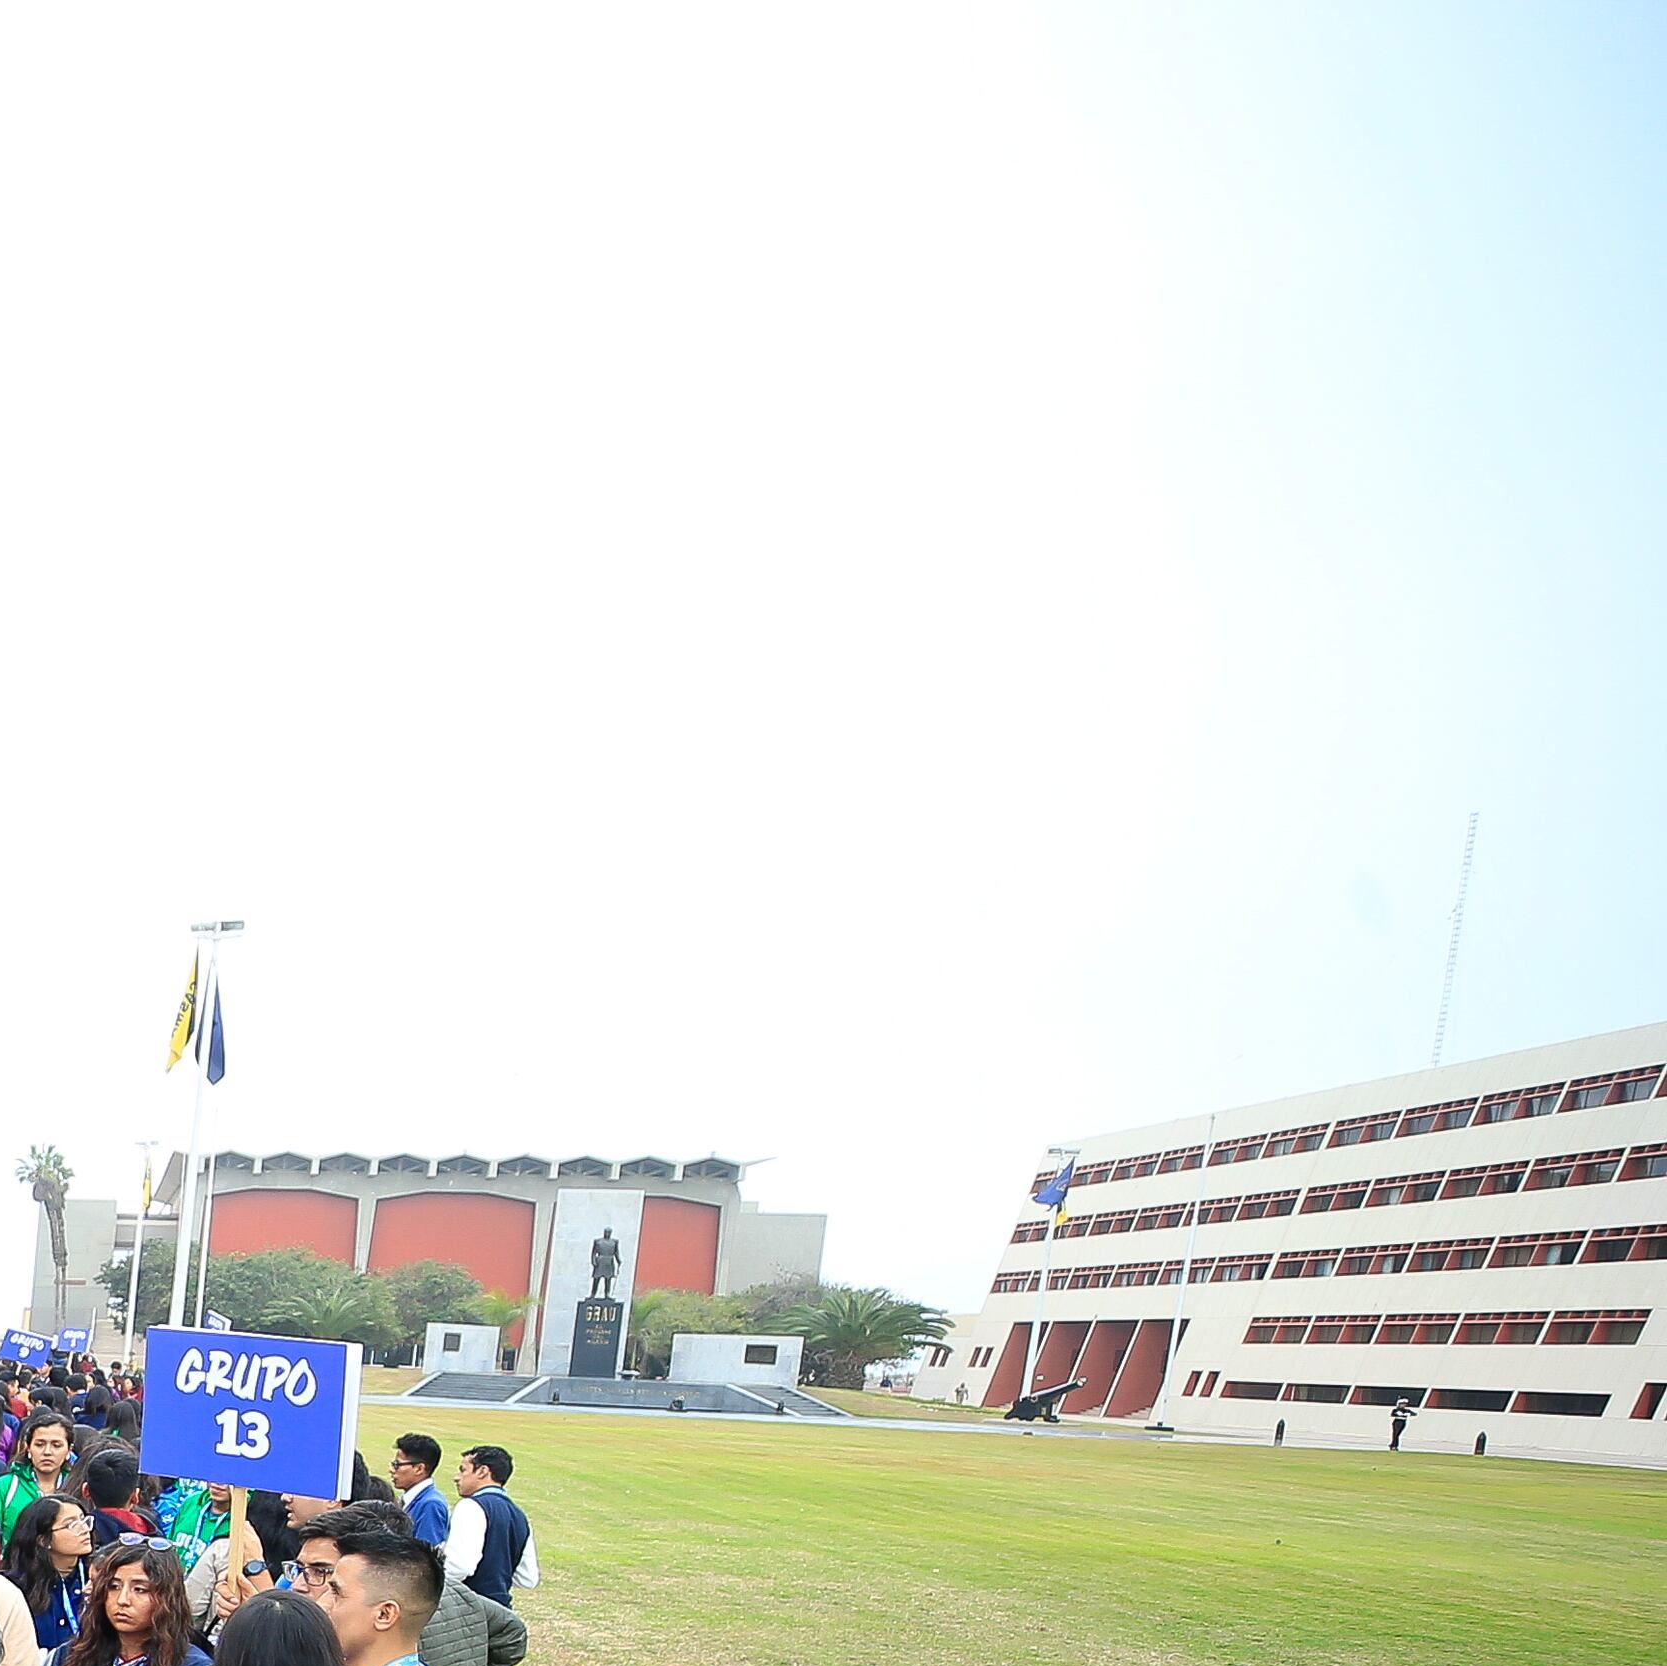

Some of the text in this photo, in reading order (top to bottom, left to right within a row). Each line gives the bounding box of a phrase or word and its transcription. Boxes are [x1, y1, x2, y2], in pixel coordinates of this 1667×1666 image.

[586, 1306, 617, 1322] GRAU
[10, 1332, 44, 1350] GRUPO
[176, 1347, 317, 1407] GRUPO
[216, 1407, 271, 1459] 13
